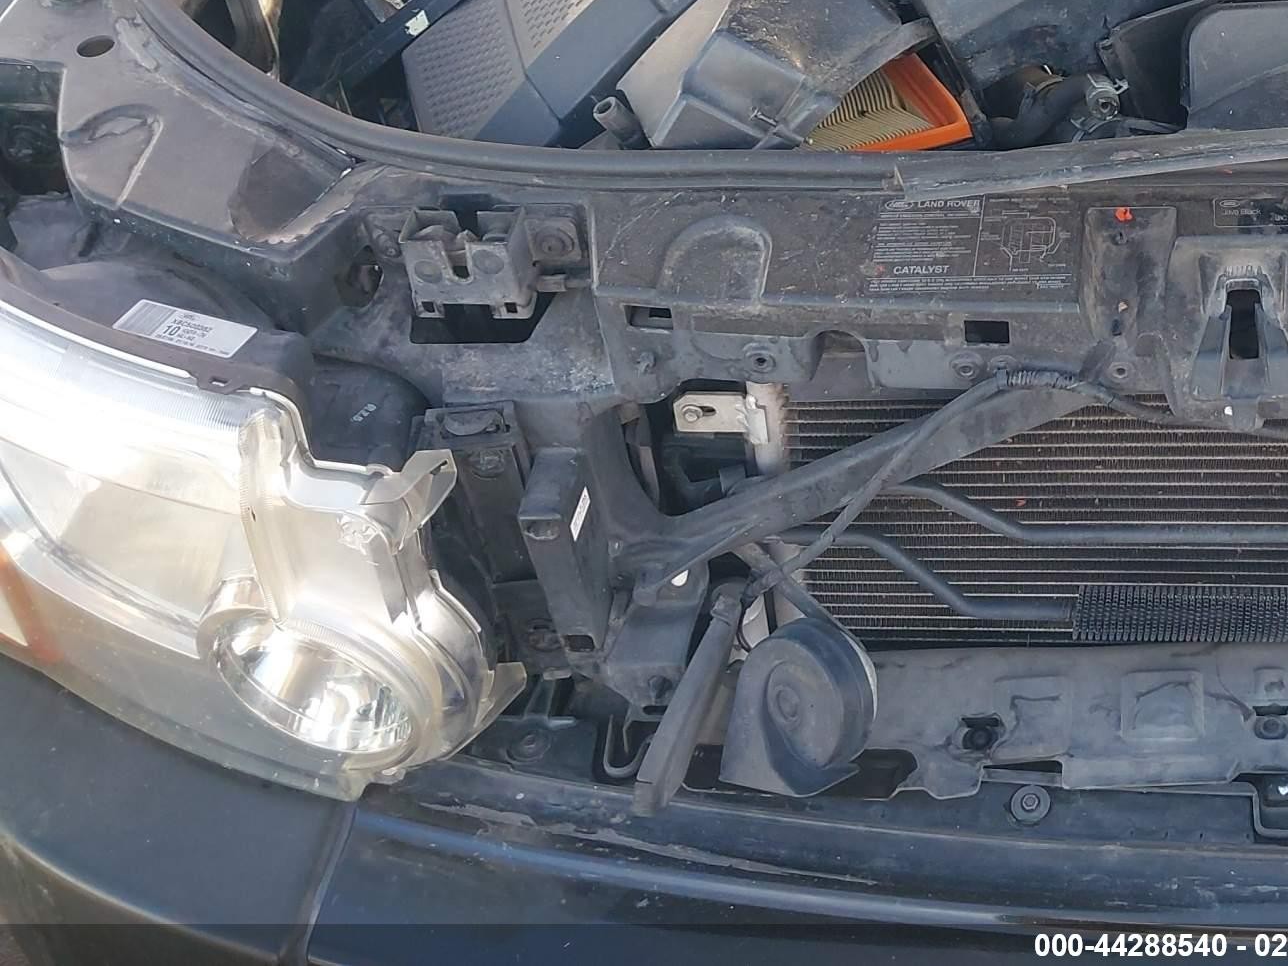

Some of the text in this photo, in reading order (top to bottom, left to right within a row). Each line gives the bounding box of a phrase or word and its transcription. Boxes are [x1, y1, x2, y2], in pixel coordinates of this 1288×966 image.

[917, 200, 945, 208] LAND
[946, 199, 981, 208] ROVER
[893, 265, 950, 275] CATALYST
[163, 324, 181, 337] 10
